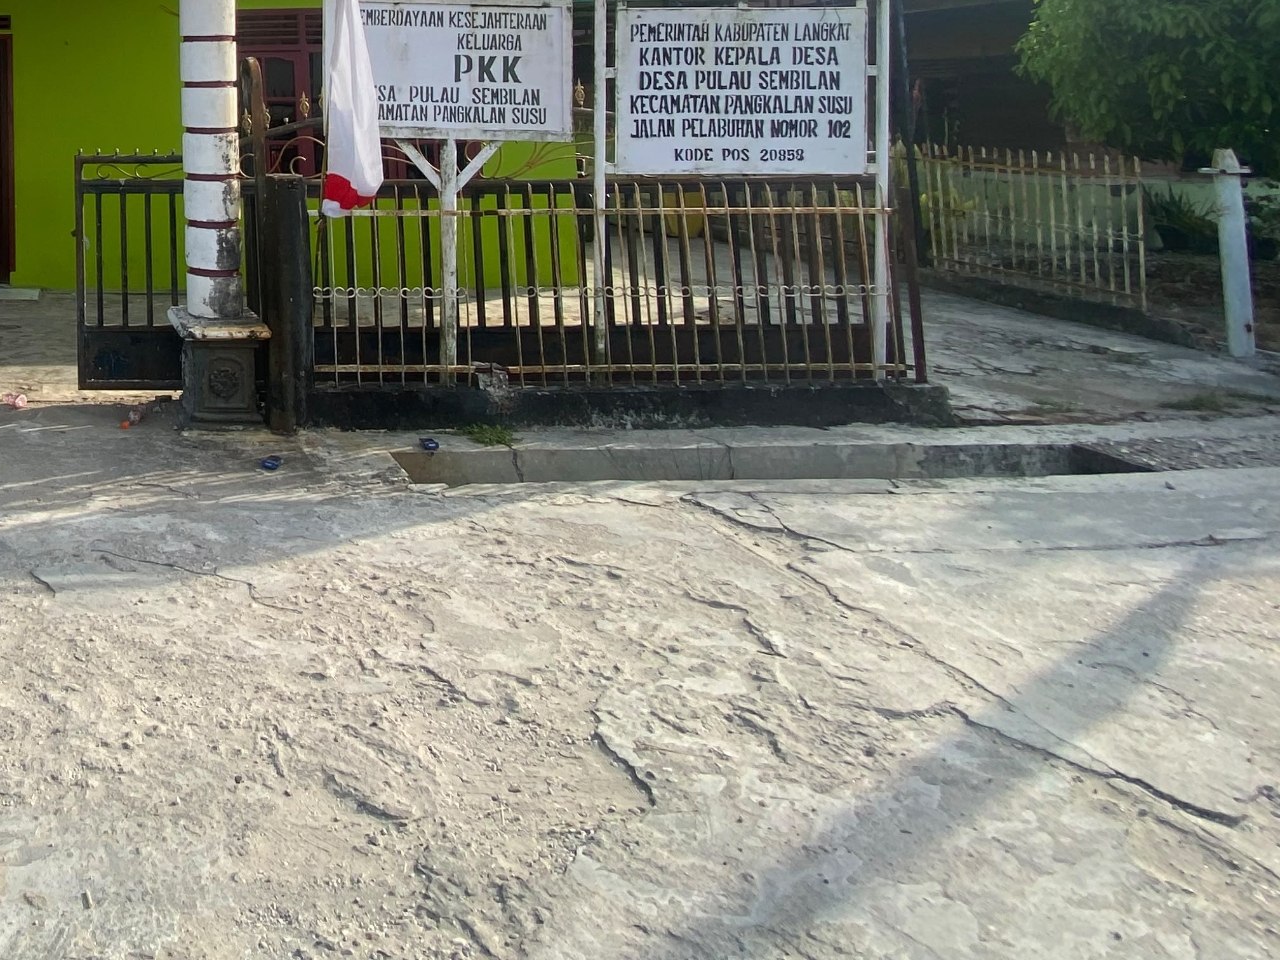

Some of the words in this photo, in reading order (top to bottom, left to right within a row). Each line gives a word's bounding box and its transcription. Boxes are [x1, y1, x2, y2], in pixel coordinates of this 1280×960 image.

[361, 10, 443, 27] EMBERDAYAAN
[449, 11, 547, 30] KESEJAHTERAAN
[630, 23, 709, 42] PEMERINTAH
[715, 23, 788, 41] KABUPATEN
[795, 23, 852, 41] LANGKAT
[457, 34, 522, 51] KELUARGA
[640, 47, 706, 66] KANTOR
[714, 47, 780, 65] KEPALA
[792, 47, 838, 65] DESA
[454, 55, 522, 83] PKK
[640, 71, 687, 90] DESA
[695, 71, 751, 90] PULAU
[759, 70, 840, 90] SEMBILAN
[374, 85, 396, 103] SA
[410, 86, 459, 104] PULAU
[472, 88, 540, 106] SEMBILAN
[630, 95, 720, 114] KECAMATAN
[724, 95, 814, 114] PANGKALAN
[818, 96, 852, 114] SUSU
[378, 104, 427, 121] AMATAN
[434, 106, 505, 124] PANGKALAN
[512, 108, 547, 125] SUSU
[631, 120, 674, 138] JALAN
[682, 119, 764, 138] PELABUHAN
[770, 120, 818, 138] NOMOR
[828, 120, 850, 138] 102
[674, 149, 713, 161] KODE
[722, 149, 749, 161] POS
[760, 148, 804, 161] 20858
